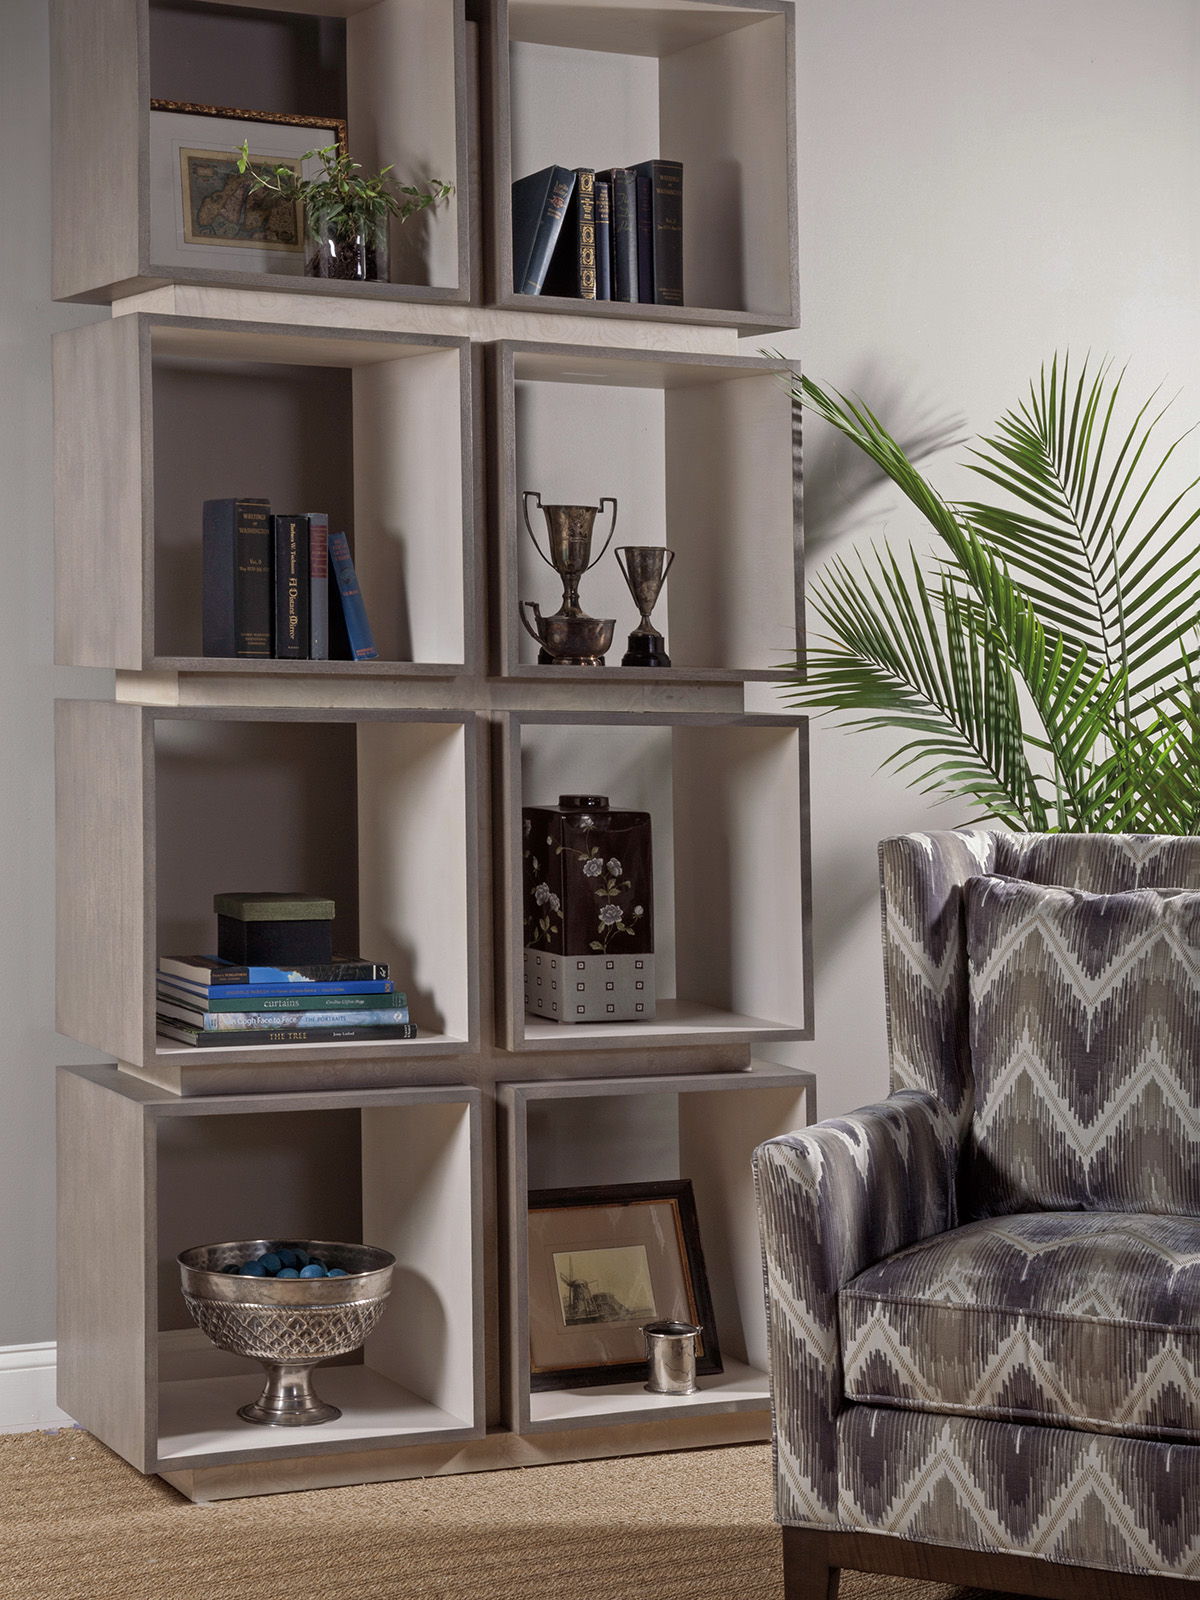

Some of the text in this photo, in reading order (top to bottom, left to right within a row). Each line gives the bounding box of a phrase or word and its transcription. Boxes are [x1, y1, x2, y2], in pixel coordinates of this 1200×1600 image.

[288, 588, 298, 614] Distant
[288, 614, 298, 640] Mirror
[263, 998, 300, 1008] curtains
[237, 1017, 257, 1026] Gogh
[257, 1016, 274, 1024] Face
[282, 1015, 298, 1024] Face
[288, 1032, 307, 1040] TREE
